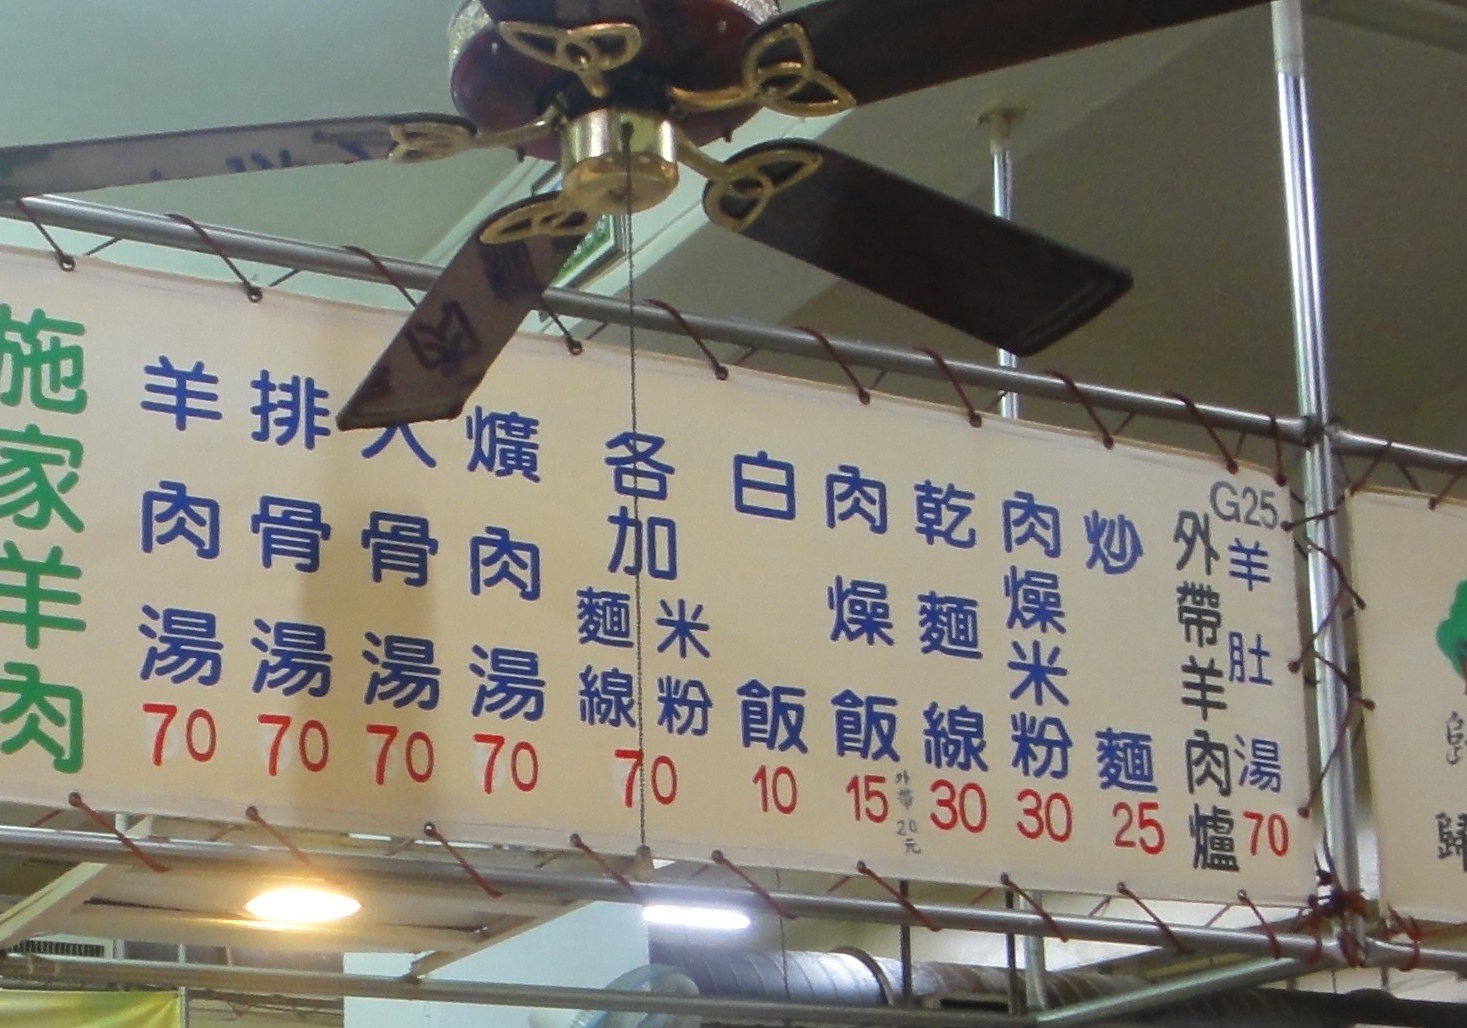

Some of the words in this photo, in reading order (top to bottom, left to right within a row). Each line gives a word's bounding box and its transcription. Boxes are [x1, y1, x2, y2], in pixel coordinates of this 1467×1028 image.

[138, 355, 224, 687] 羊肉湯
[250, 368, 333, 698] 排骨湯
[466, 405, 547, 722] 爌肉湯
[604, 430, 678, 581] 各加
[1209, 479, 1279, 531] G25
[576, 586, 637, 729] 麵線
[655, 598, 714, 737] 米粉
[733, 450, 808, 755] 白飯
[825, 464, 901, 763] 肉燥飯
[914, 479, 990, 773] 乾麵線
[1002, 490, 1074, 780] 肉燥米粉
[1083, 509, 1159, 794] 炒麵
[1228, 538, 1283, 794] 羊肚湯
[142, 703, 217, 767] 70
[257, 713, 332, 777] 70
[365, 723, 435, 786] 70
[1173, 510, 1240, 874] 外帶羊肉爐
[473, 733, 540, 795] 70
[614, 748, 678, 808] 70
[752, 765, 799, 815] 10
[845, 774, 890, 824] 15
[929, 778, 988, 834] 30
[1016, 788, 1073, 843] 30
[1112, 801, 1166, 856] 25
[1242, 810, 1290, 858] 70
